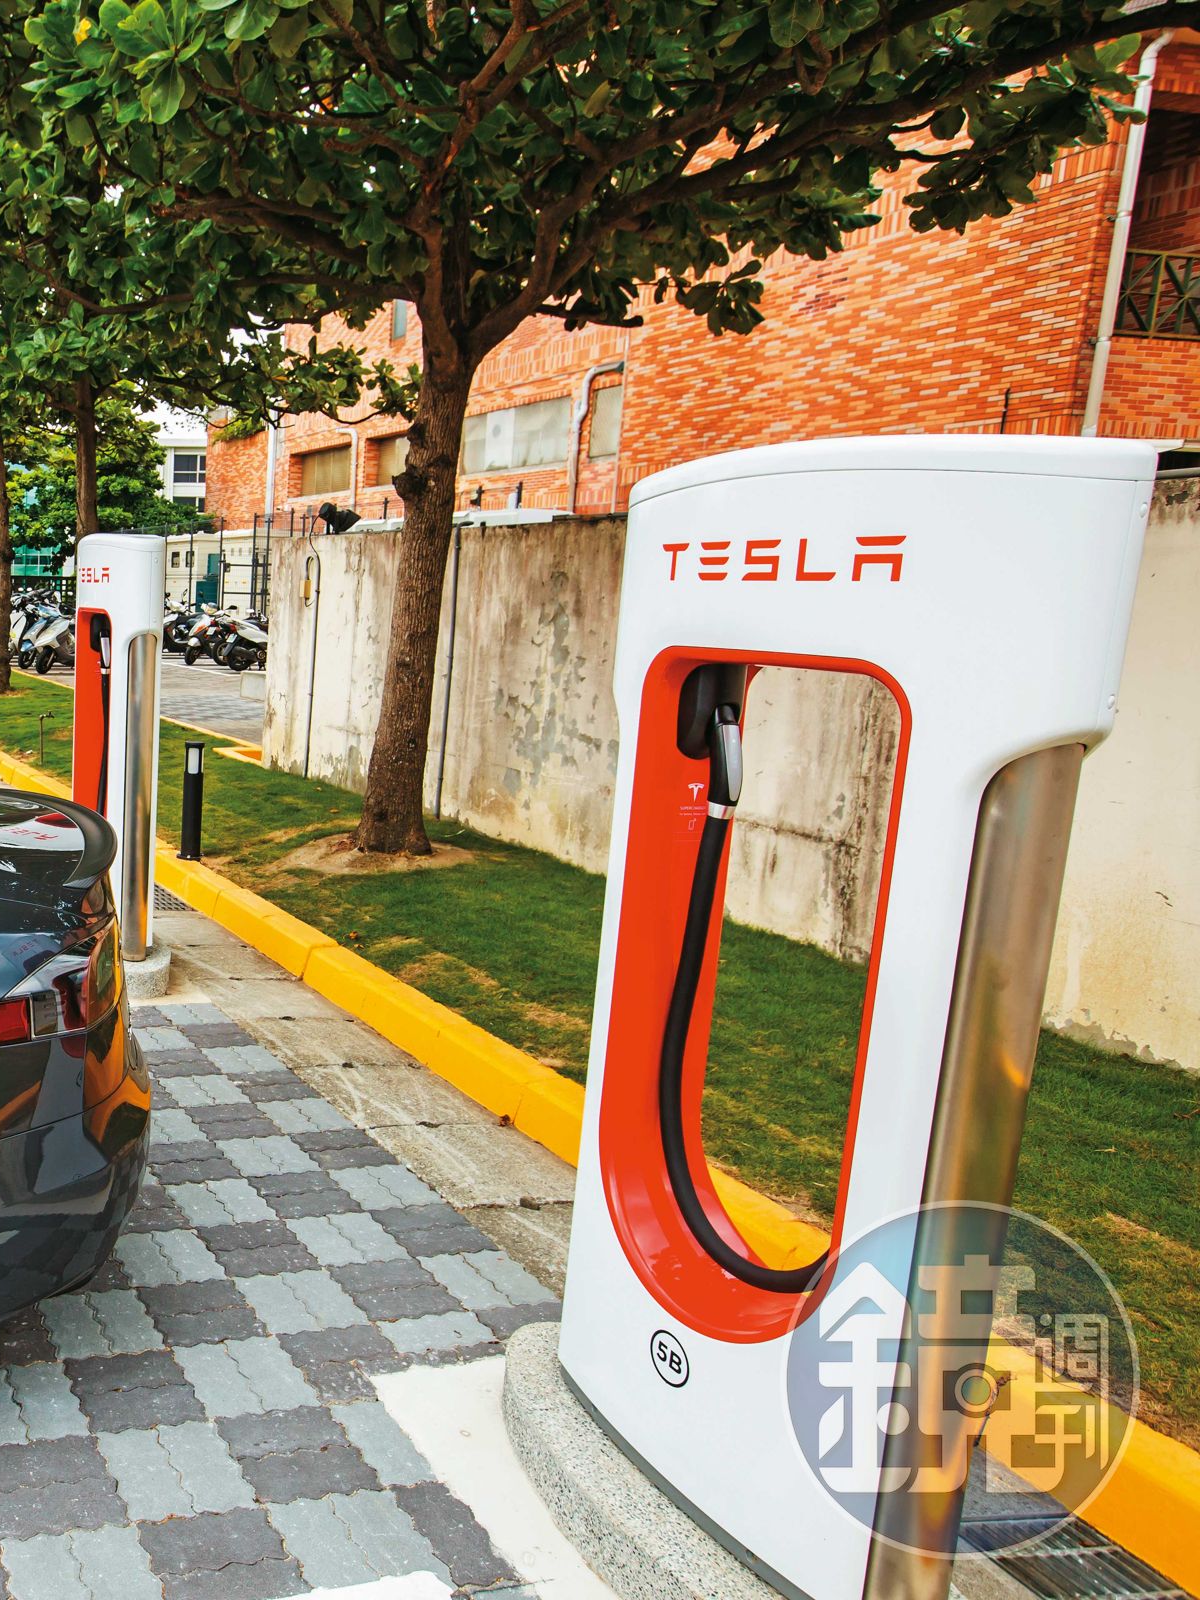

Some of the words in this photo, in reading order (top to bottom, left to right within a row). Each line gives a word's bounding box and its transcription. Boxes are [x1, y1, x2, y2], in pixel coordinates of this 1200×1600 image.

[79, 567, 110, 583] ESLA
[663, 535, 907, 581] TESLA
[656, 1340, 682, 1374] 5B
